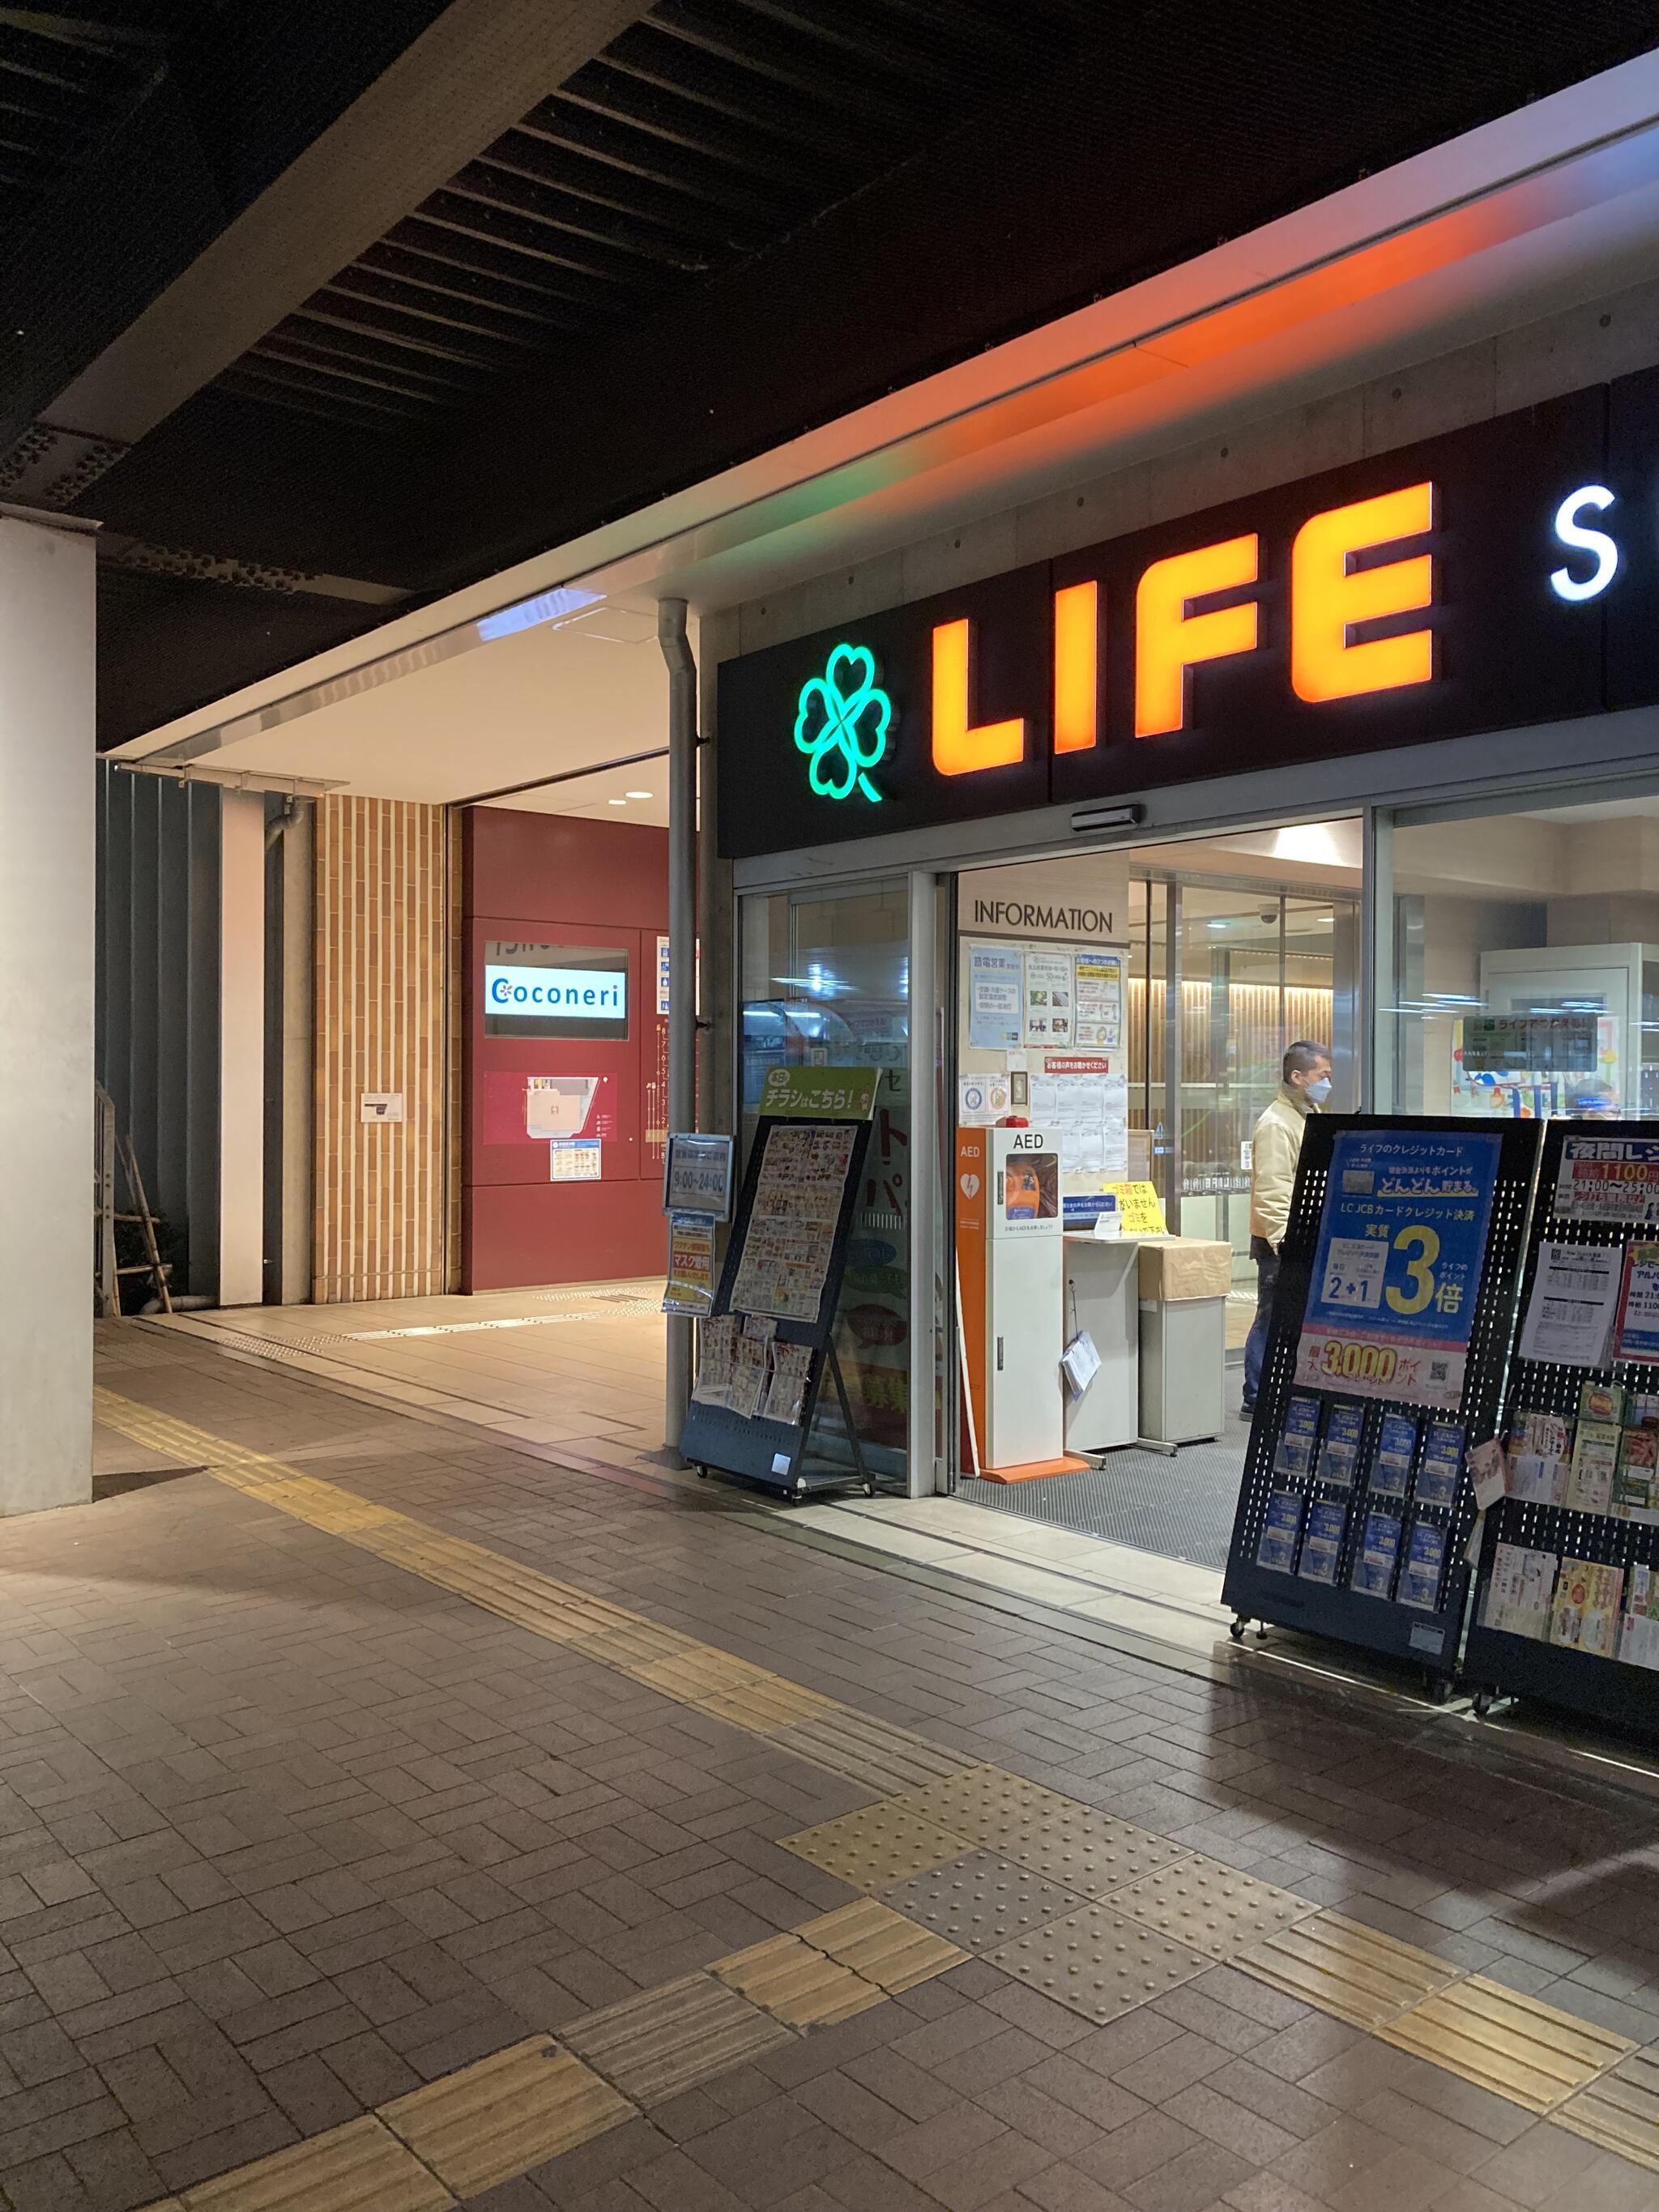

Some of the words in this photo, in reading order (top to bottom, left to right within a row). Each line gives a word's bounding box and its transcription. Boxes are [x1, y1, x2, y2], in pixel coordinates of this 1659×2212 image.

[932, 481, 1433, 777] LIFE
[1551, 484, 1618, 602] S
[975, 899, 1113, 934] INFORMATION
[492, 978, 617, 1006] Coconeri
[1013, 1134, 1044, 1149] AED
[1360, 1143, 1464, 1157] ライフのクレジットカード
[960, 1146, 980, 1158] AED
[1341, 1202, 1354, 1213] LC
[1364, 1222, 1392, 1239] 実質
[674, 1253, 710, 1271] マスク着用
[1385, 1225, 1440, 1315] 3
[1435, 1281, 1465, 1315] 倍
